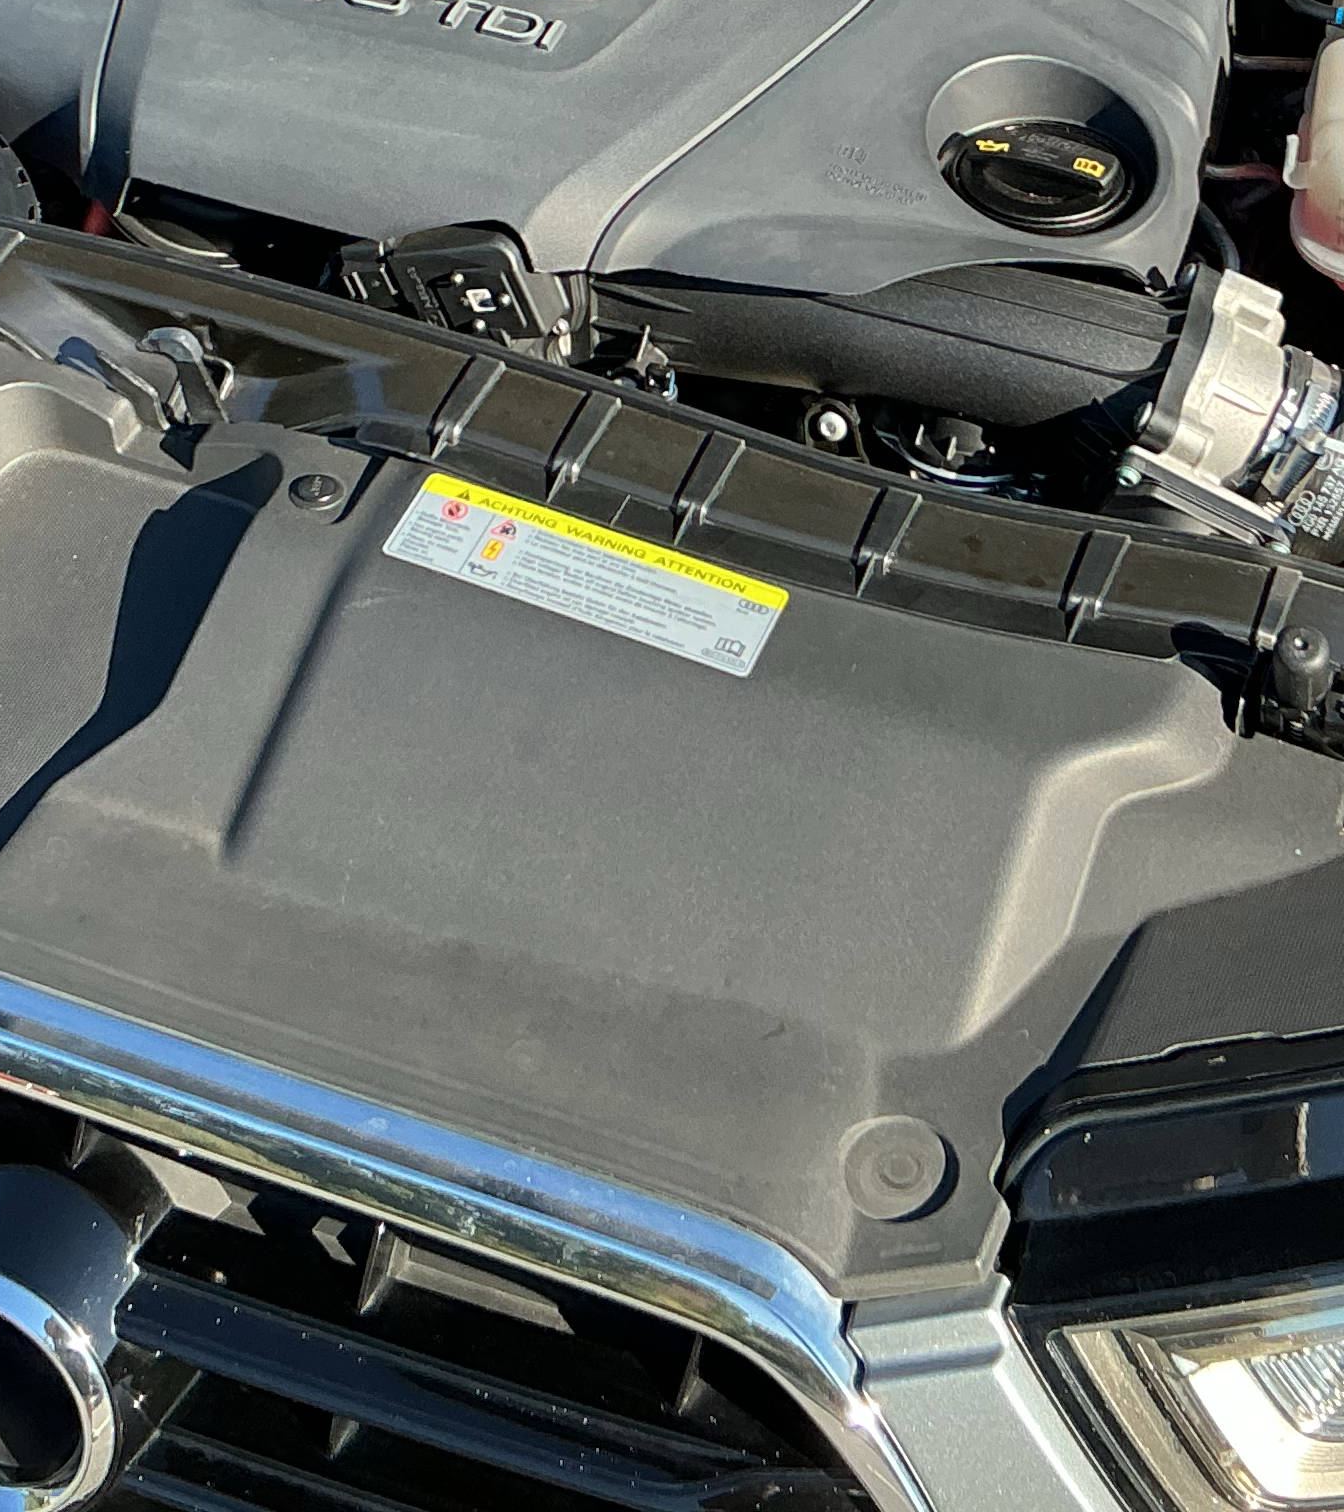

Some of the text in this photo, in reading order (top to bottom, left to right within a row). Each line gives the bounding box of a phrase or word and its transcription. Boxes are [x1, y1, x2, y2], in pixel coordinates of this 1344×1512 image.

[478, 497, 748, 594] ACHTUNG WARNING ATTENTION
